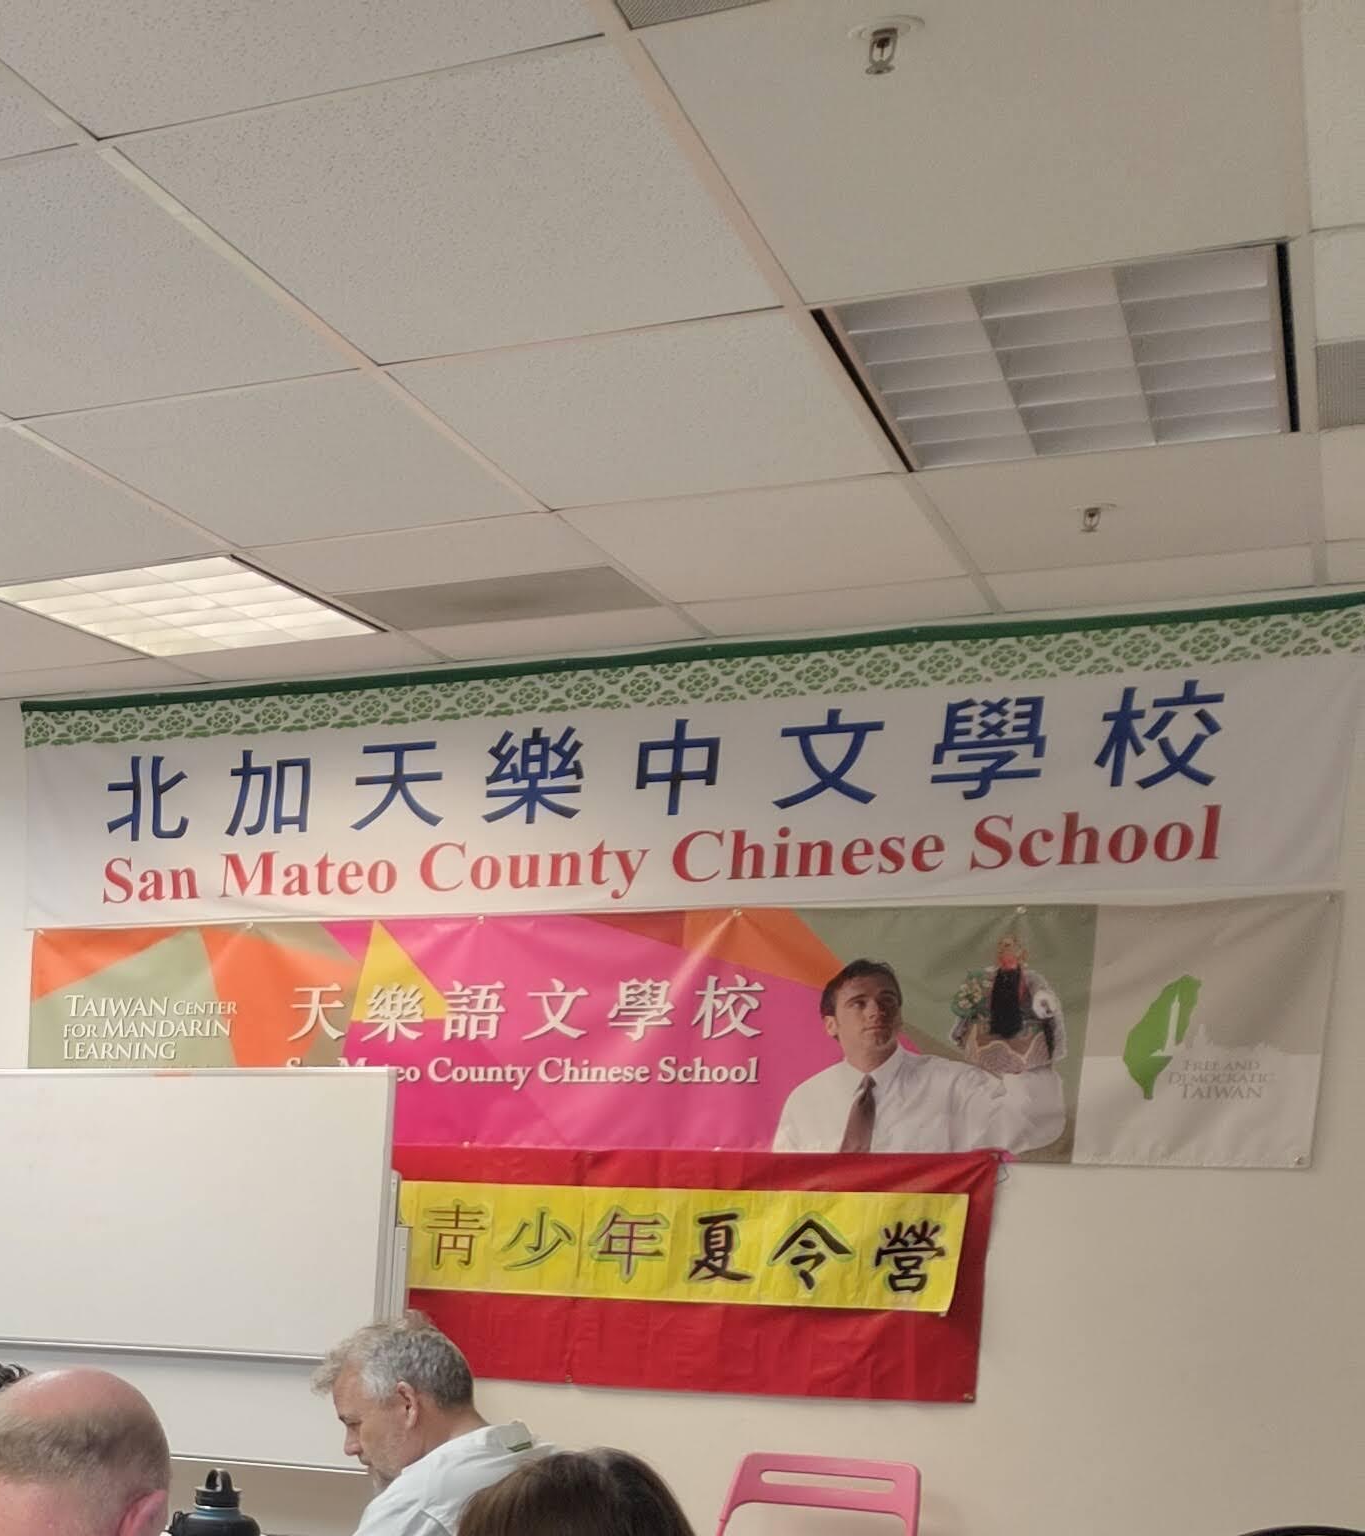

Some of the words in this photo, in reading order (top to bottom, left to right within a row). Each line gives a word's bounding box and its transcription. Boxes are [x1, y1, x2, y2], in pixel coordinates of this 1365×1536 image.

[106, 679, 1225, 842] 北加天樂中文學校
[102, 857, 199, 905] San
[219, 850, 398, 899] Mateo
[418, 839, 649, 899] County
[672, 825, 945, 884] Chinese
[969, 804, 1223, 872] School
[64, 994, 170, 1017] TAIWAN
[173, 999, 237, 1015] CENTER
[287, 978, 766, 1043] 天樂語文學校
[62, 1023, 98, 1039] FOR
[102, 1019, 231, 1038] MANDARIN
[63, 1039, 176, 1061] LEARNING
[427, 1058, 530, 1091] County
[538, 1057, 650, 1084] Chinese
[656, 1056, 758, 1084] School
[1181, 1085, 1262, 1099] TAIWAN
